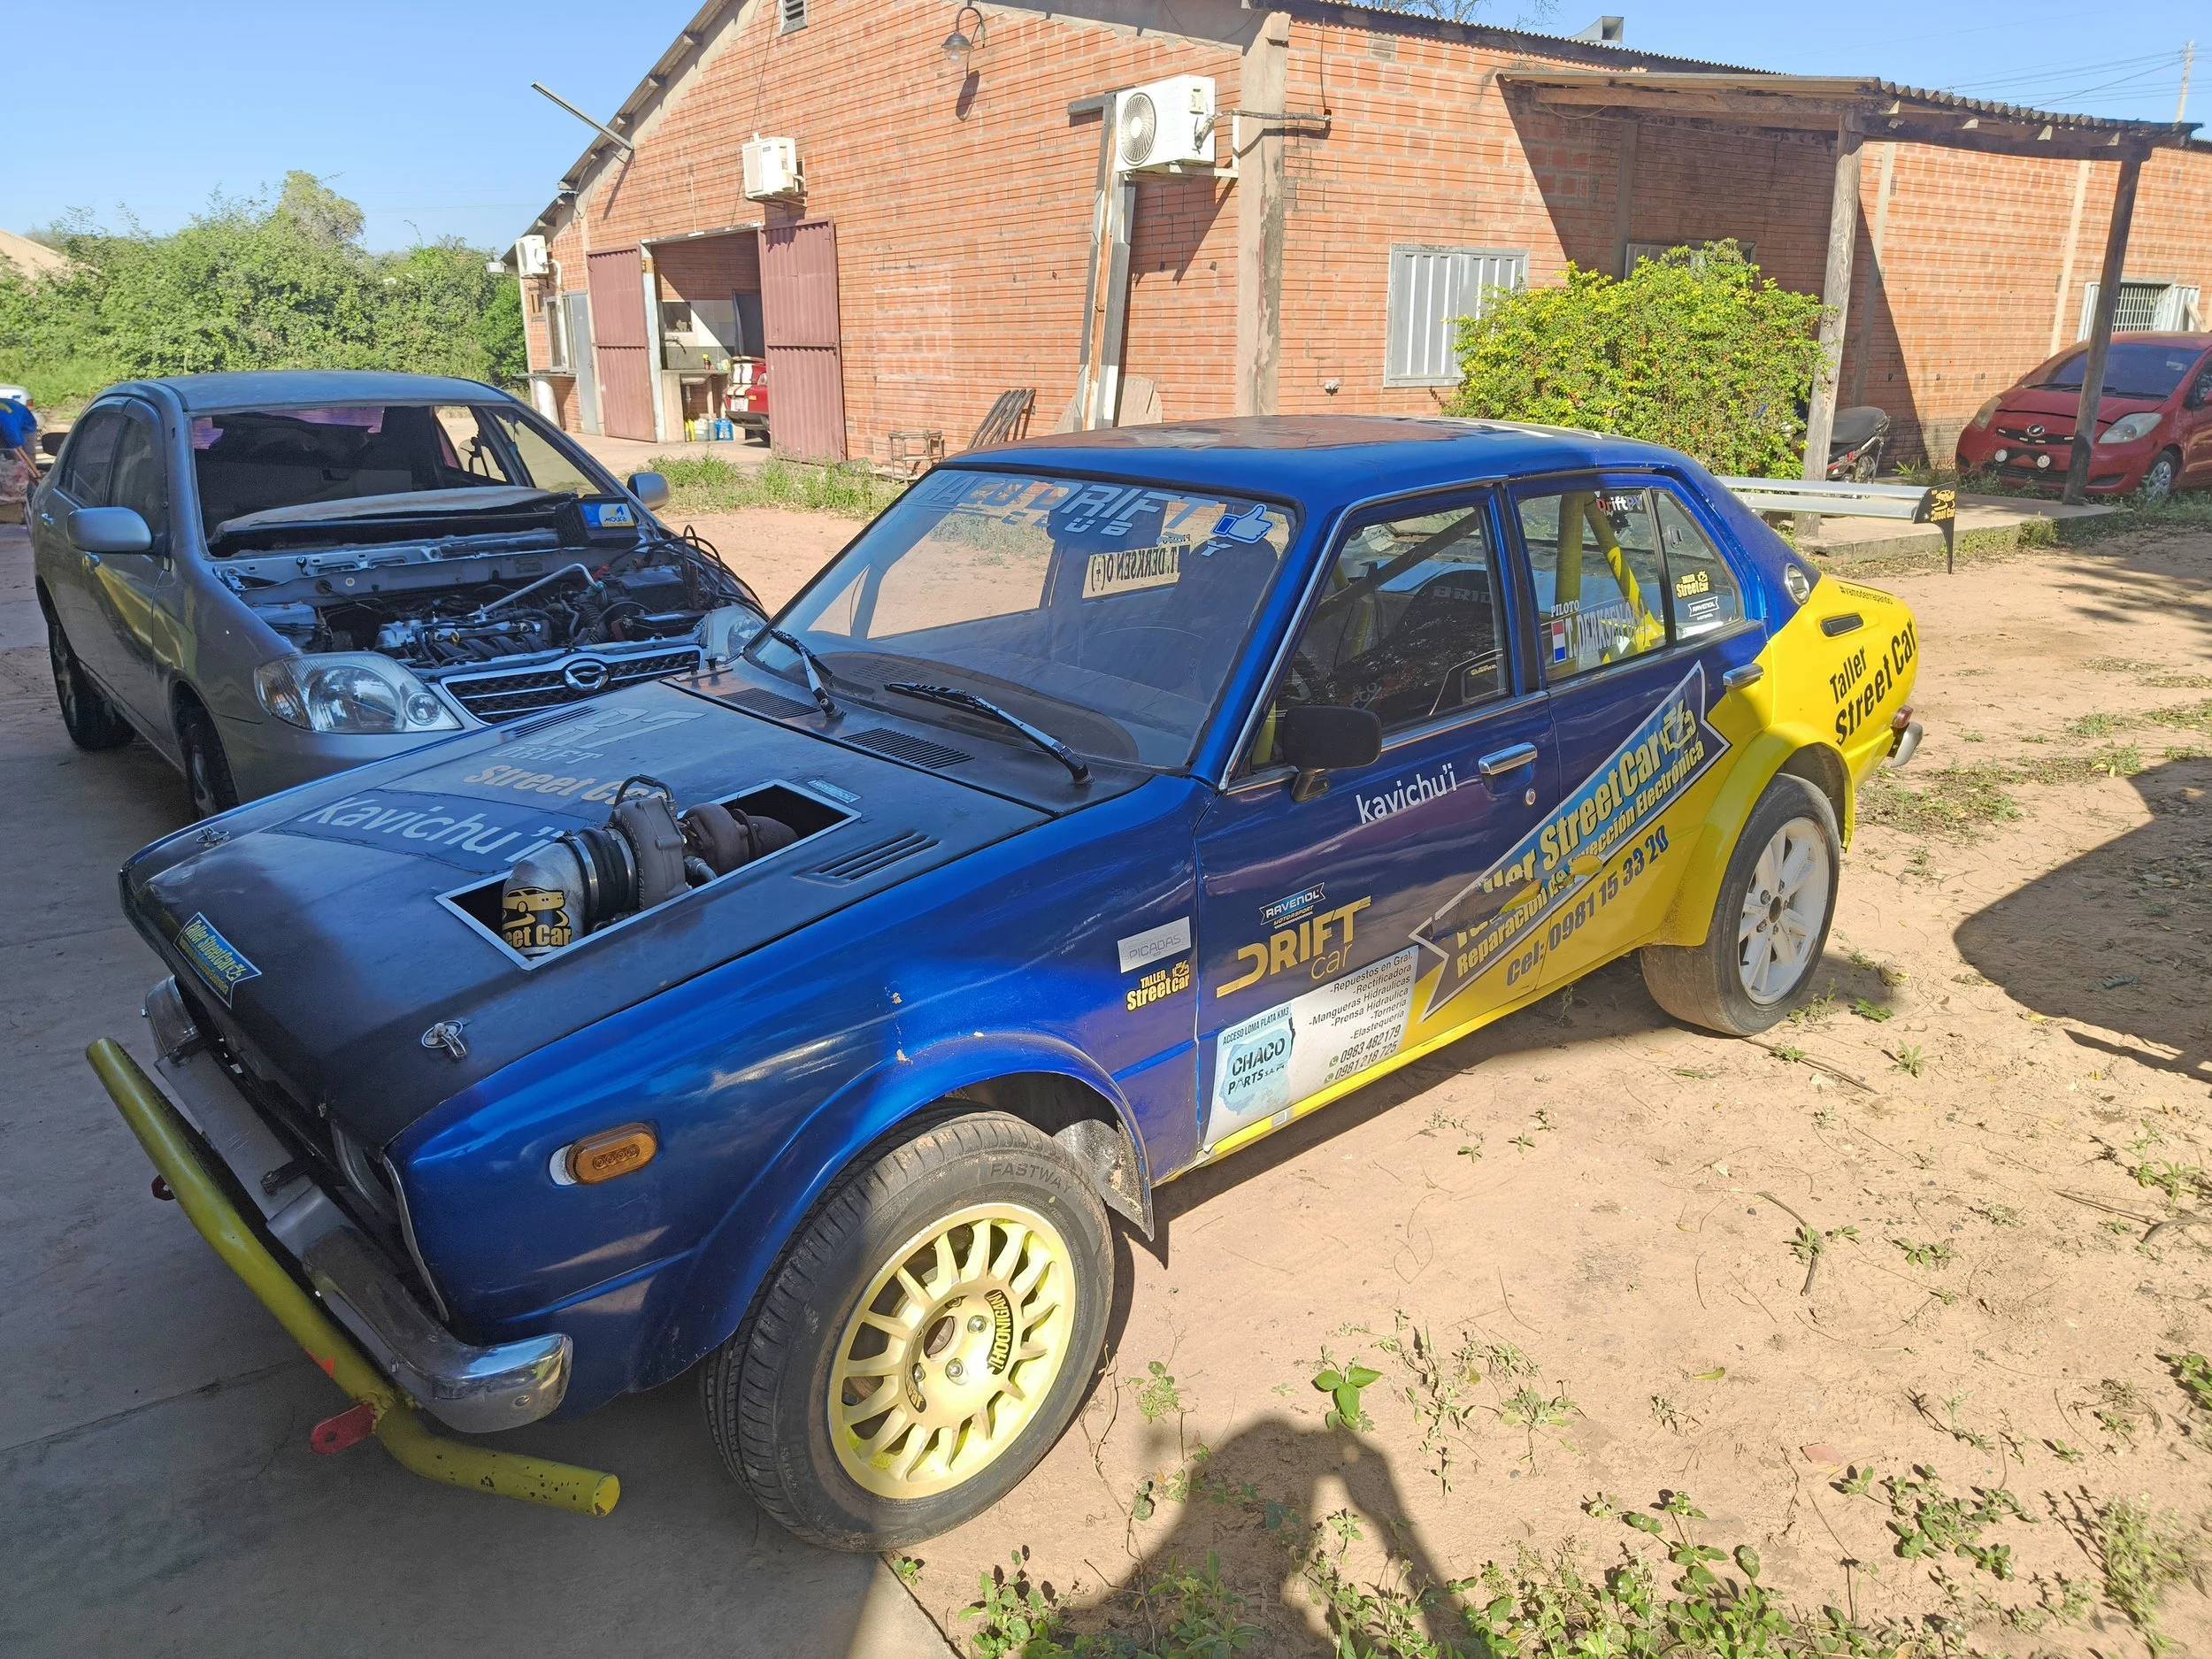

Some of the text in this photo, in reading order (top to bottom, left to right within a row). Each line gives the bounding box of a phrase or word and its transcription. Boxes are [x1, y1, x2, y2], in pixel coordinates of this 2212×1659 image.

[1027, 480, 1221, 530] DRIFT
[1551, 599, 1580, 618] PILOTO
[1830, 645, 1867, 705] Taller
[1835, 618, 1916, 747] Street Car
[489, 745, 605, 766] DRIFT
[463, 764, 596, 796] Street
[1635, 738, 1706, 819] Electrónica
[1548, 891, 1595, 952] 0981
[1598, 871, 1619, 908] 15
[1623, 847, 1645, 887] 33
[1644, 825, 1671, 864] 20
[1274, 905, 1315, 926] MOTORSPORT
[535, 924, 572, 948] Car
[1129, 934, 1182, 961] PICADAS
[1310, 943, 1353, 980] car
[1380, 962, 1392, 973] en
[1140, 969, 1167, 989] TALLER
[1362, 975, 1411, 1002] Hidraulicas
[1366, 987, 1409, 1015] Hidraulica
[1222, 1006, 1290, 1046] ACCESO LOMA PLATA KM3
[1231, 1037, 1286, 1077] CHACO
[1334, 1040, 1400, 1081] 0981 218 725
[1339, 1024, 1402, 1065] 0983 482179
[1227, 1066, 1264, 1096] PARTS
[989, 1162, 1073, 1194] FASTWAY
